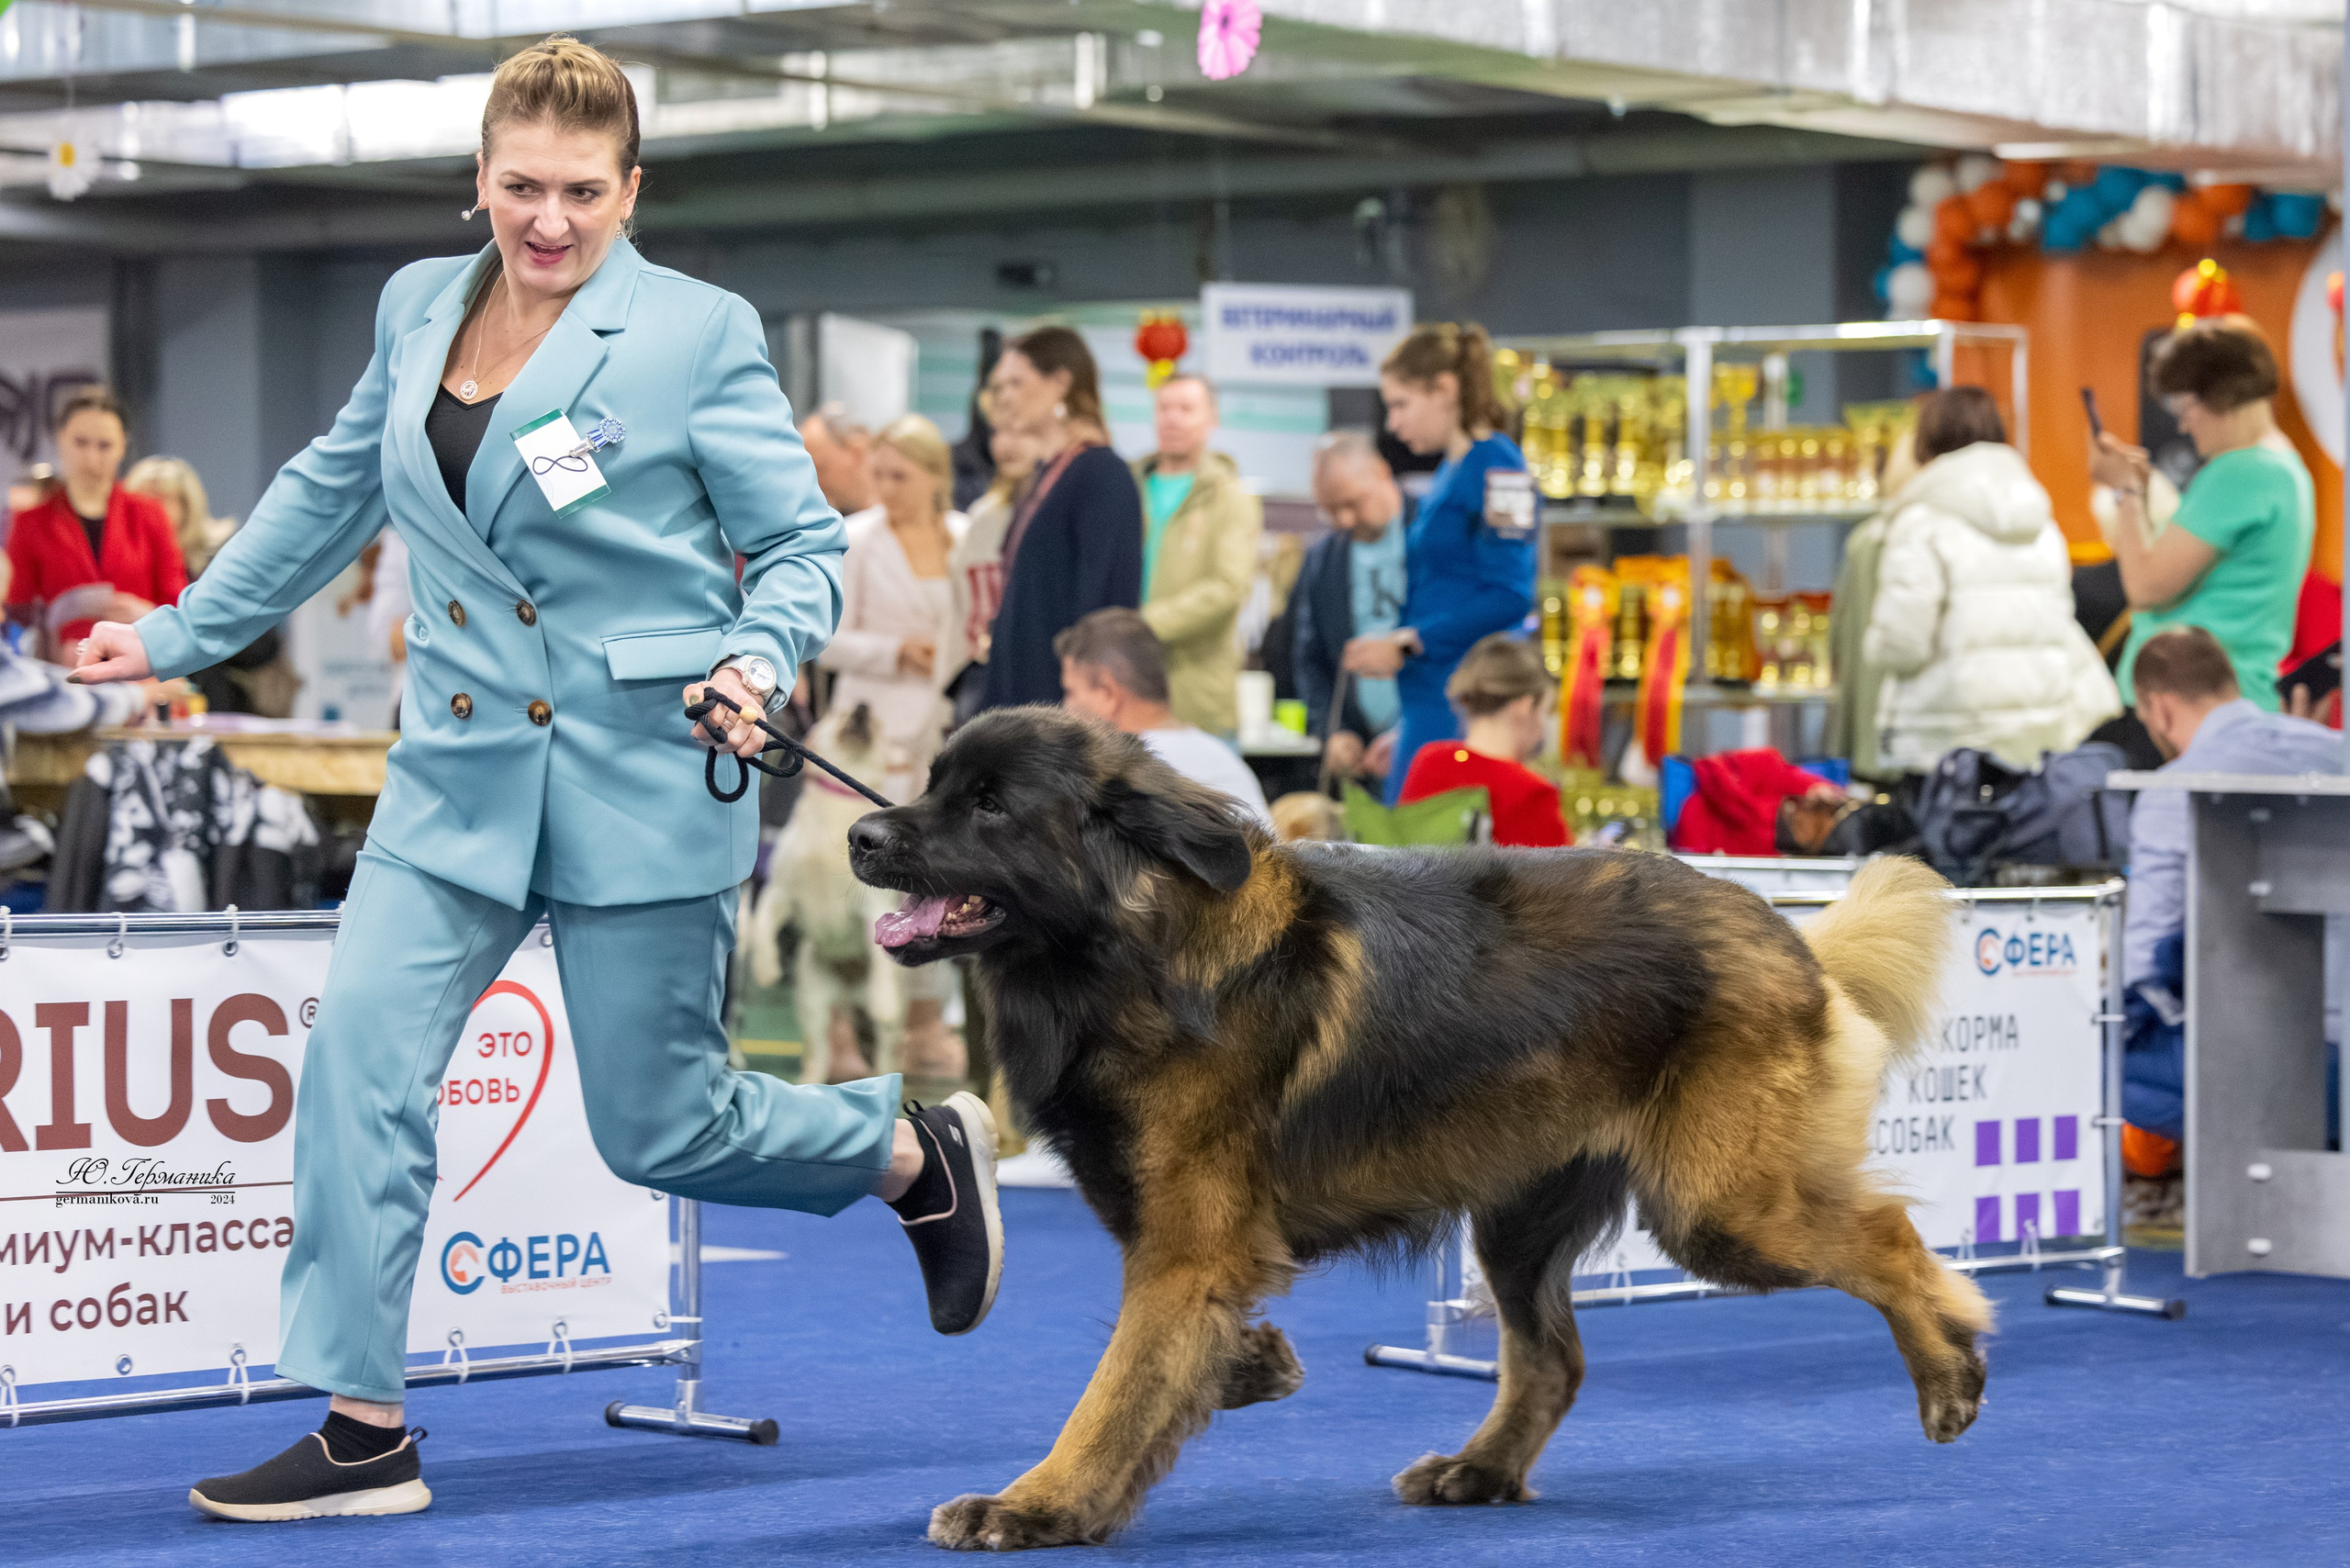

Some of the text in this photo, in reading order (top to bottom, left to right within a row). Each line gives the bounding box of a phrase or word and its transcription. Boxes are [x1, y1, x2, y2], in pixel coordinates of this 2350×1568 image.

[1975, 927, 2076, 976] СФЕРА
[477, 1031, 532, 1058] ЭТО
[1941, 1014, 2020, 1052] КОРМА
[438, 1078, 520, 1105] БОВЬ
[1908, 1064, 1987, 1103] КОШЕК
[1876, 1114, 1955, 1154] СОБАК
[441, 1231, 611, 1295] СФЕРА
[5, 1282, 189, 1336] и собак
